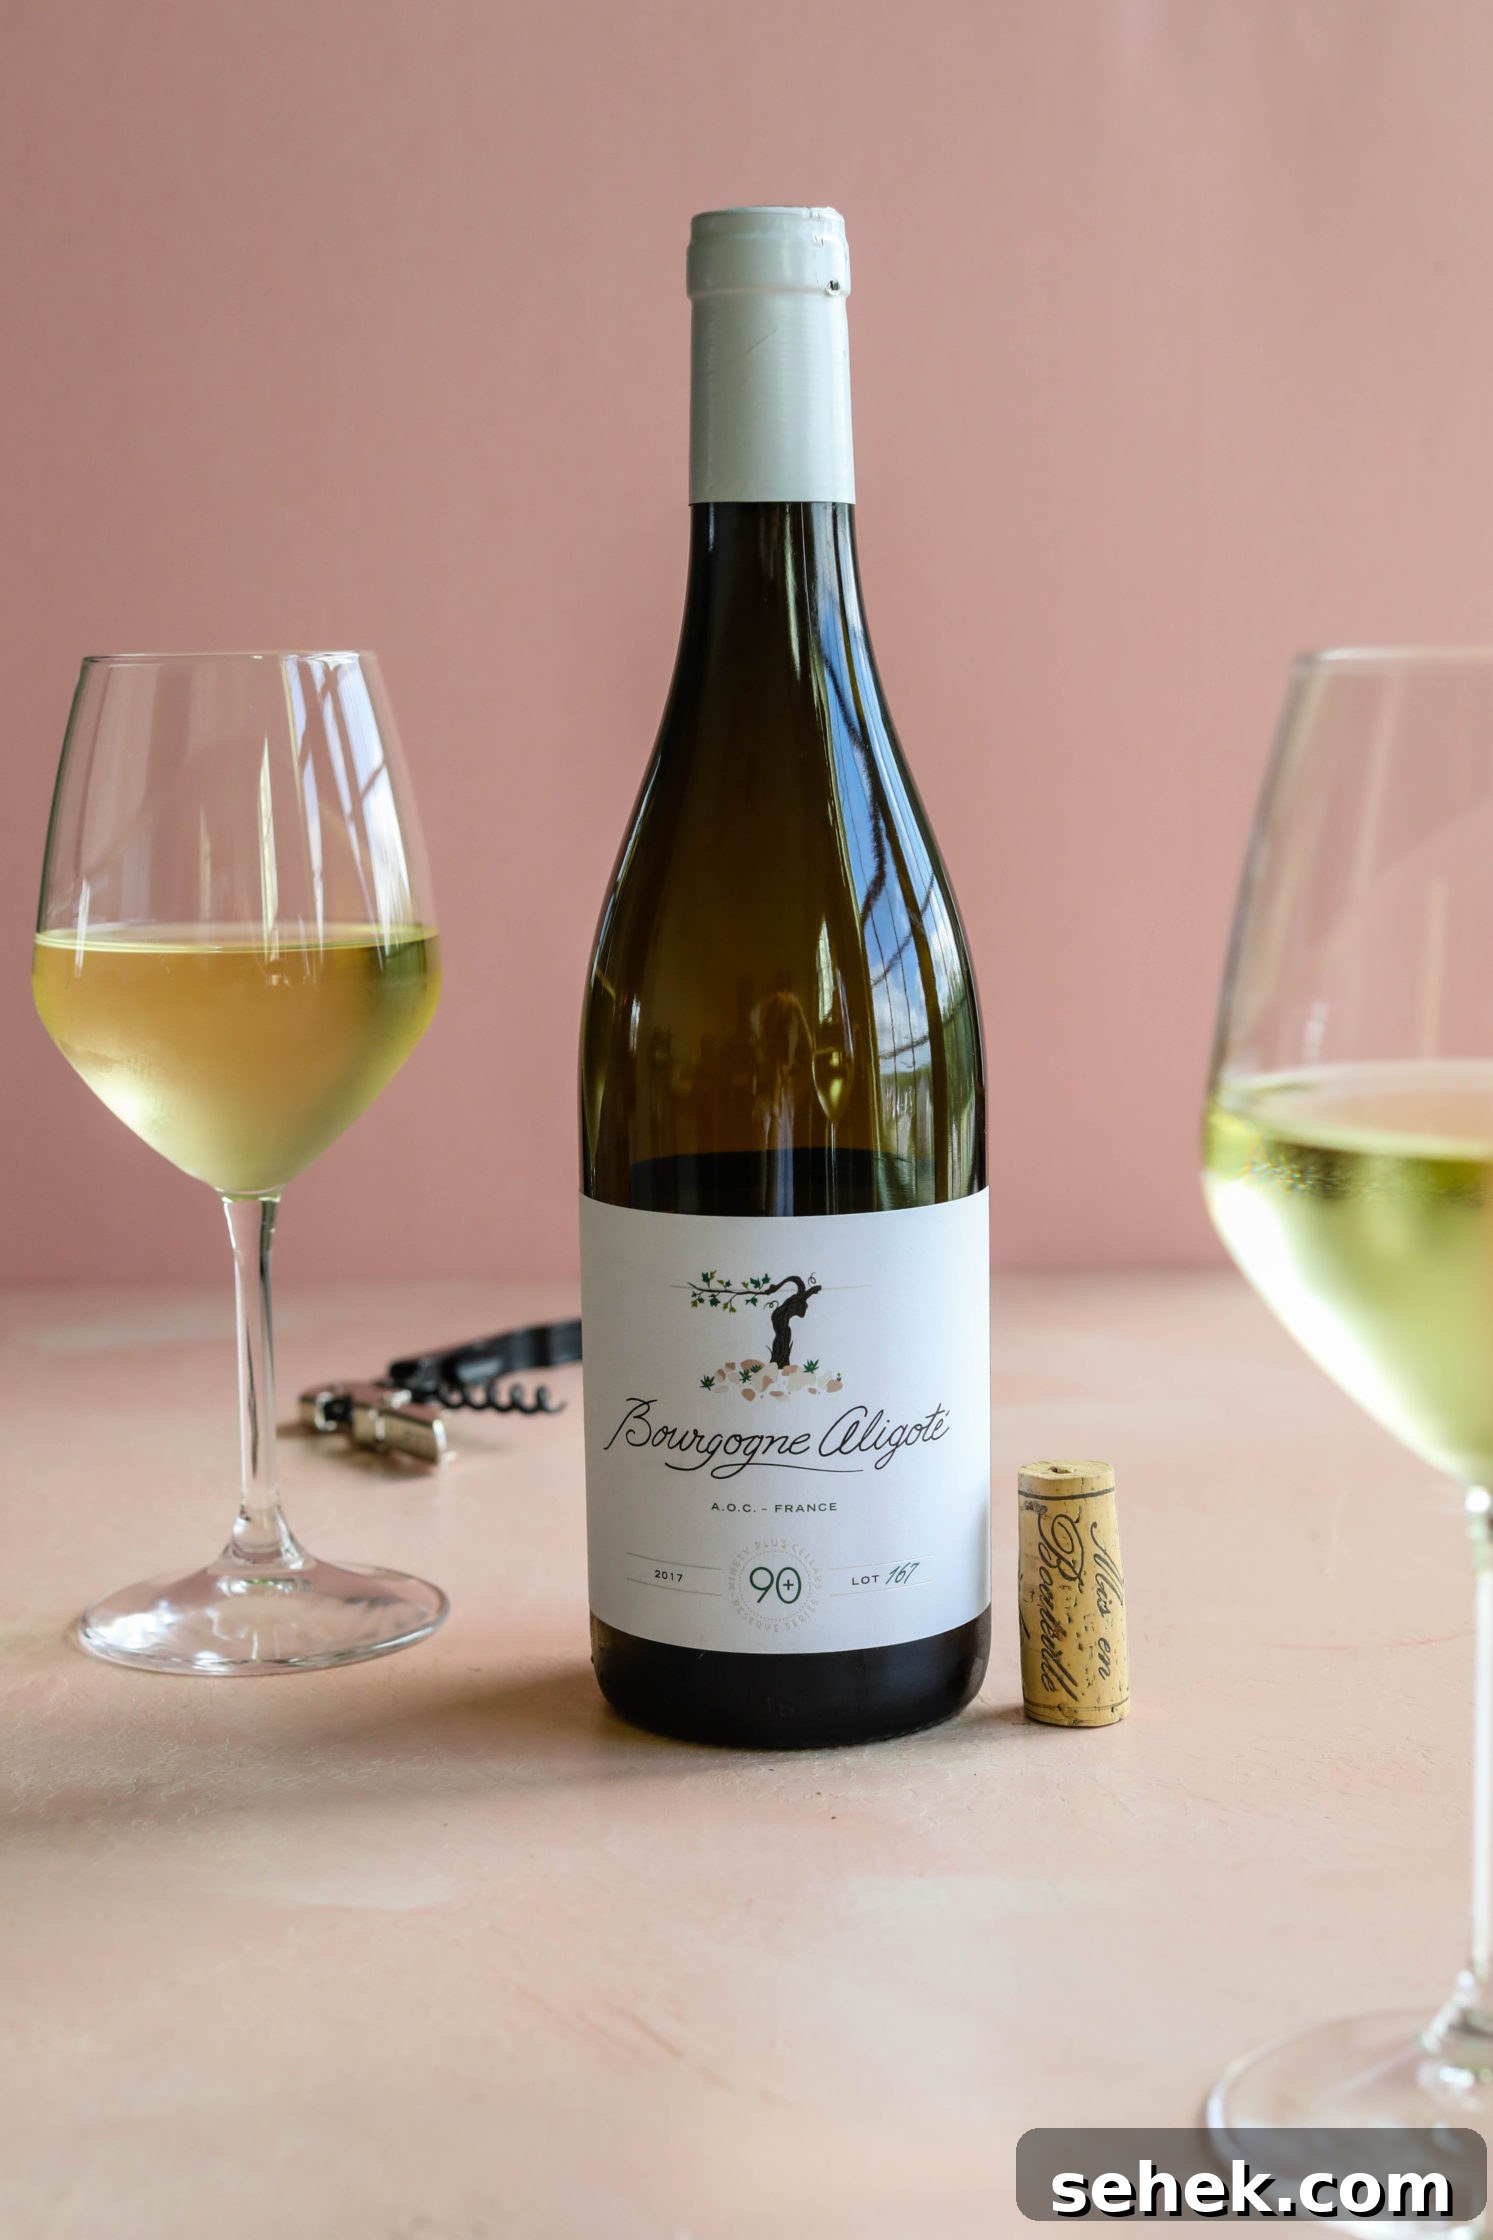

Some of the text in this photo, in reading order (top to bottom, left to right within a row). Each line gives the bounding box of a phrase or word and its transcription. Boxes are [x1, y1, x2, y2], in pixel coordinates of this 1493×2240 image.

[603, 1397, 951, 1479] Bourgogne Aligoté
[710, 1501, 757, 1514] A.O.C.
[774, 1501, 838, 1514] FRANCE
[653, 1568, 684, 1583] 2017
[851, 1560, 921, 1587] LOT 167
[1097, 1636, 1112, 1681] en
